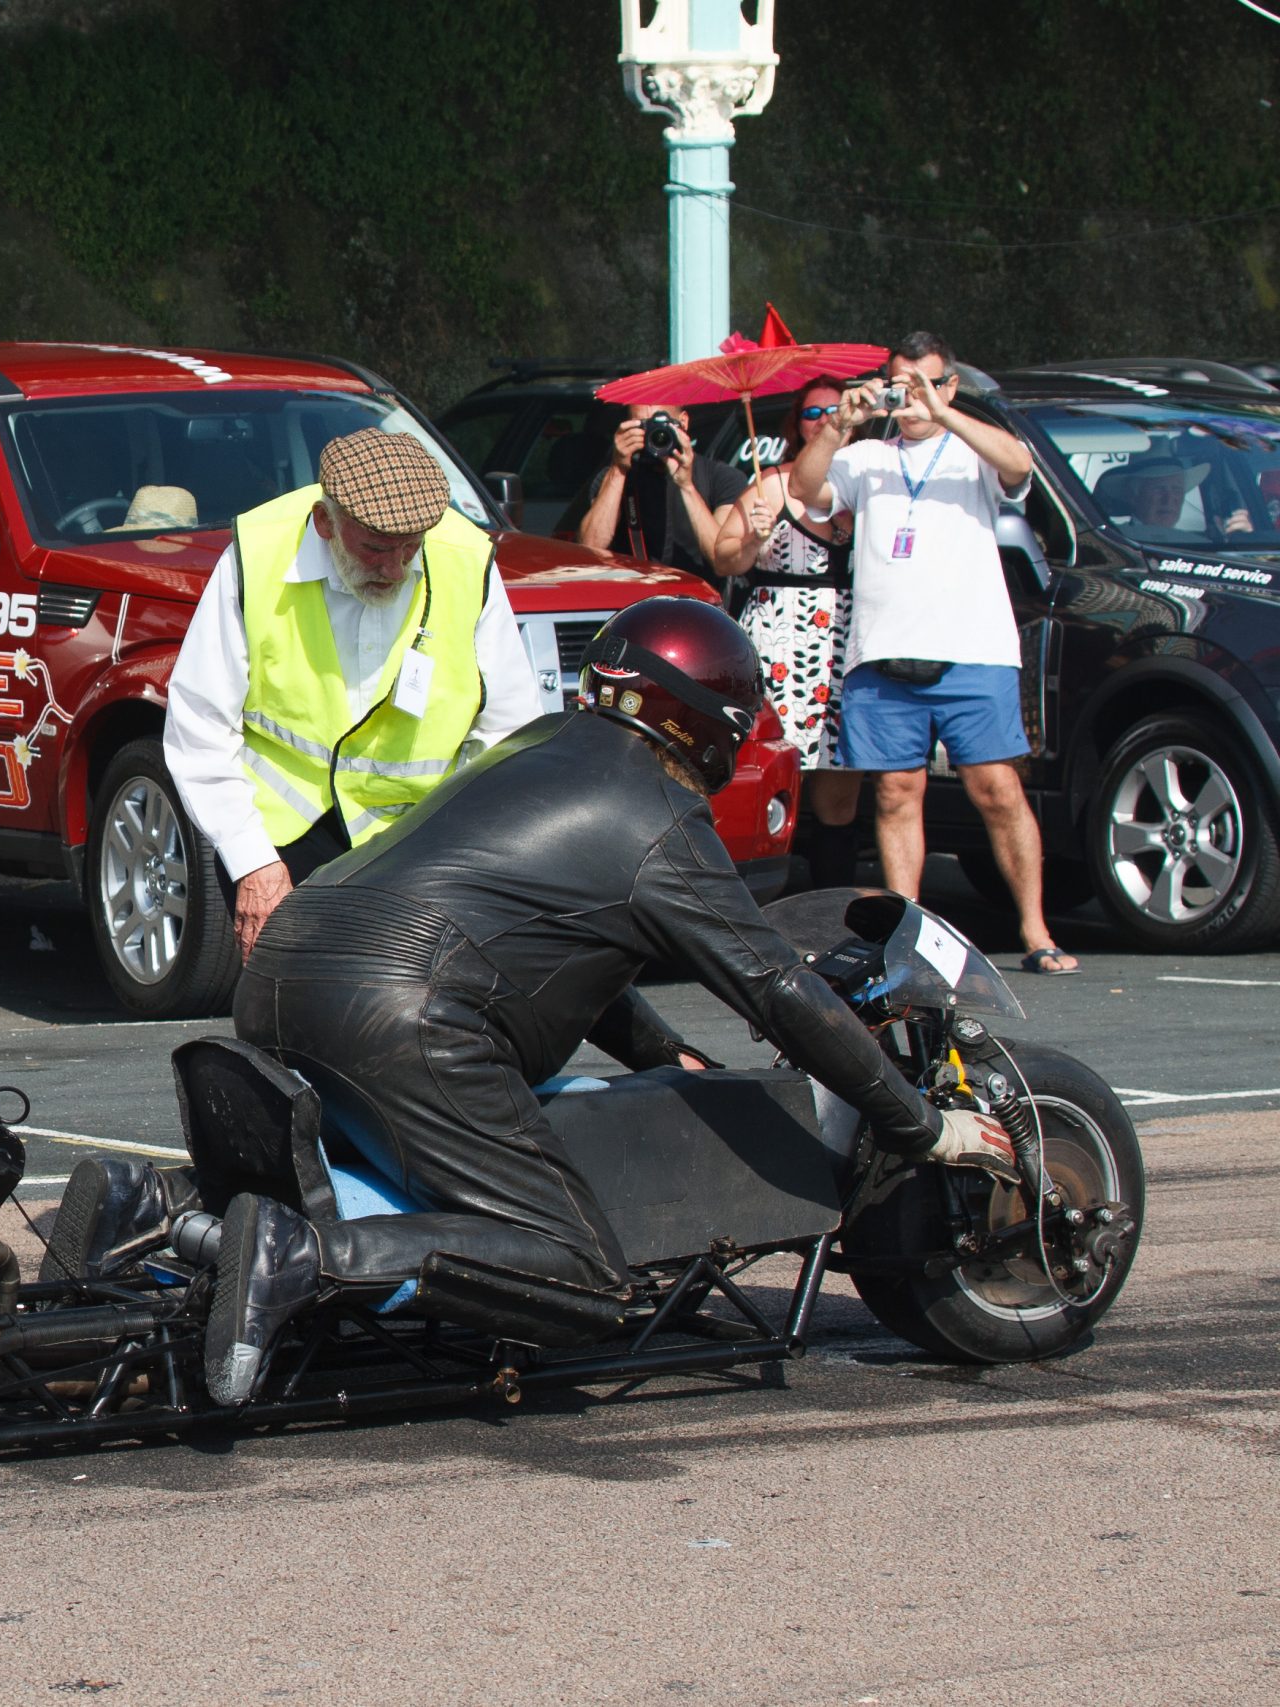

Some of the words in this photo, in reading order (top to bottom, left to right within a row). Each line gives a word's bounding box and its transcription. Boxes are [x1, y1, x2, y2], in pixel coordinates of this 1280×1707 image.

[740, 436, 787, 462] COU
[1159, 558, 1194, 573] sales
[1193, 563, 1224, 577] and
[1222, 568, 1272, 585] service
